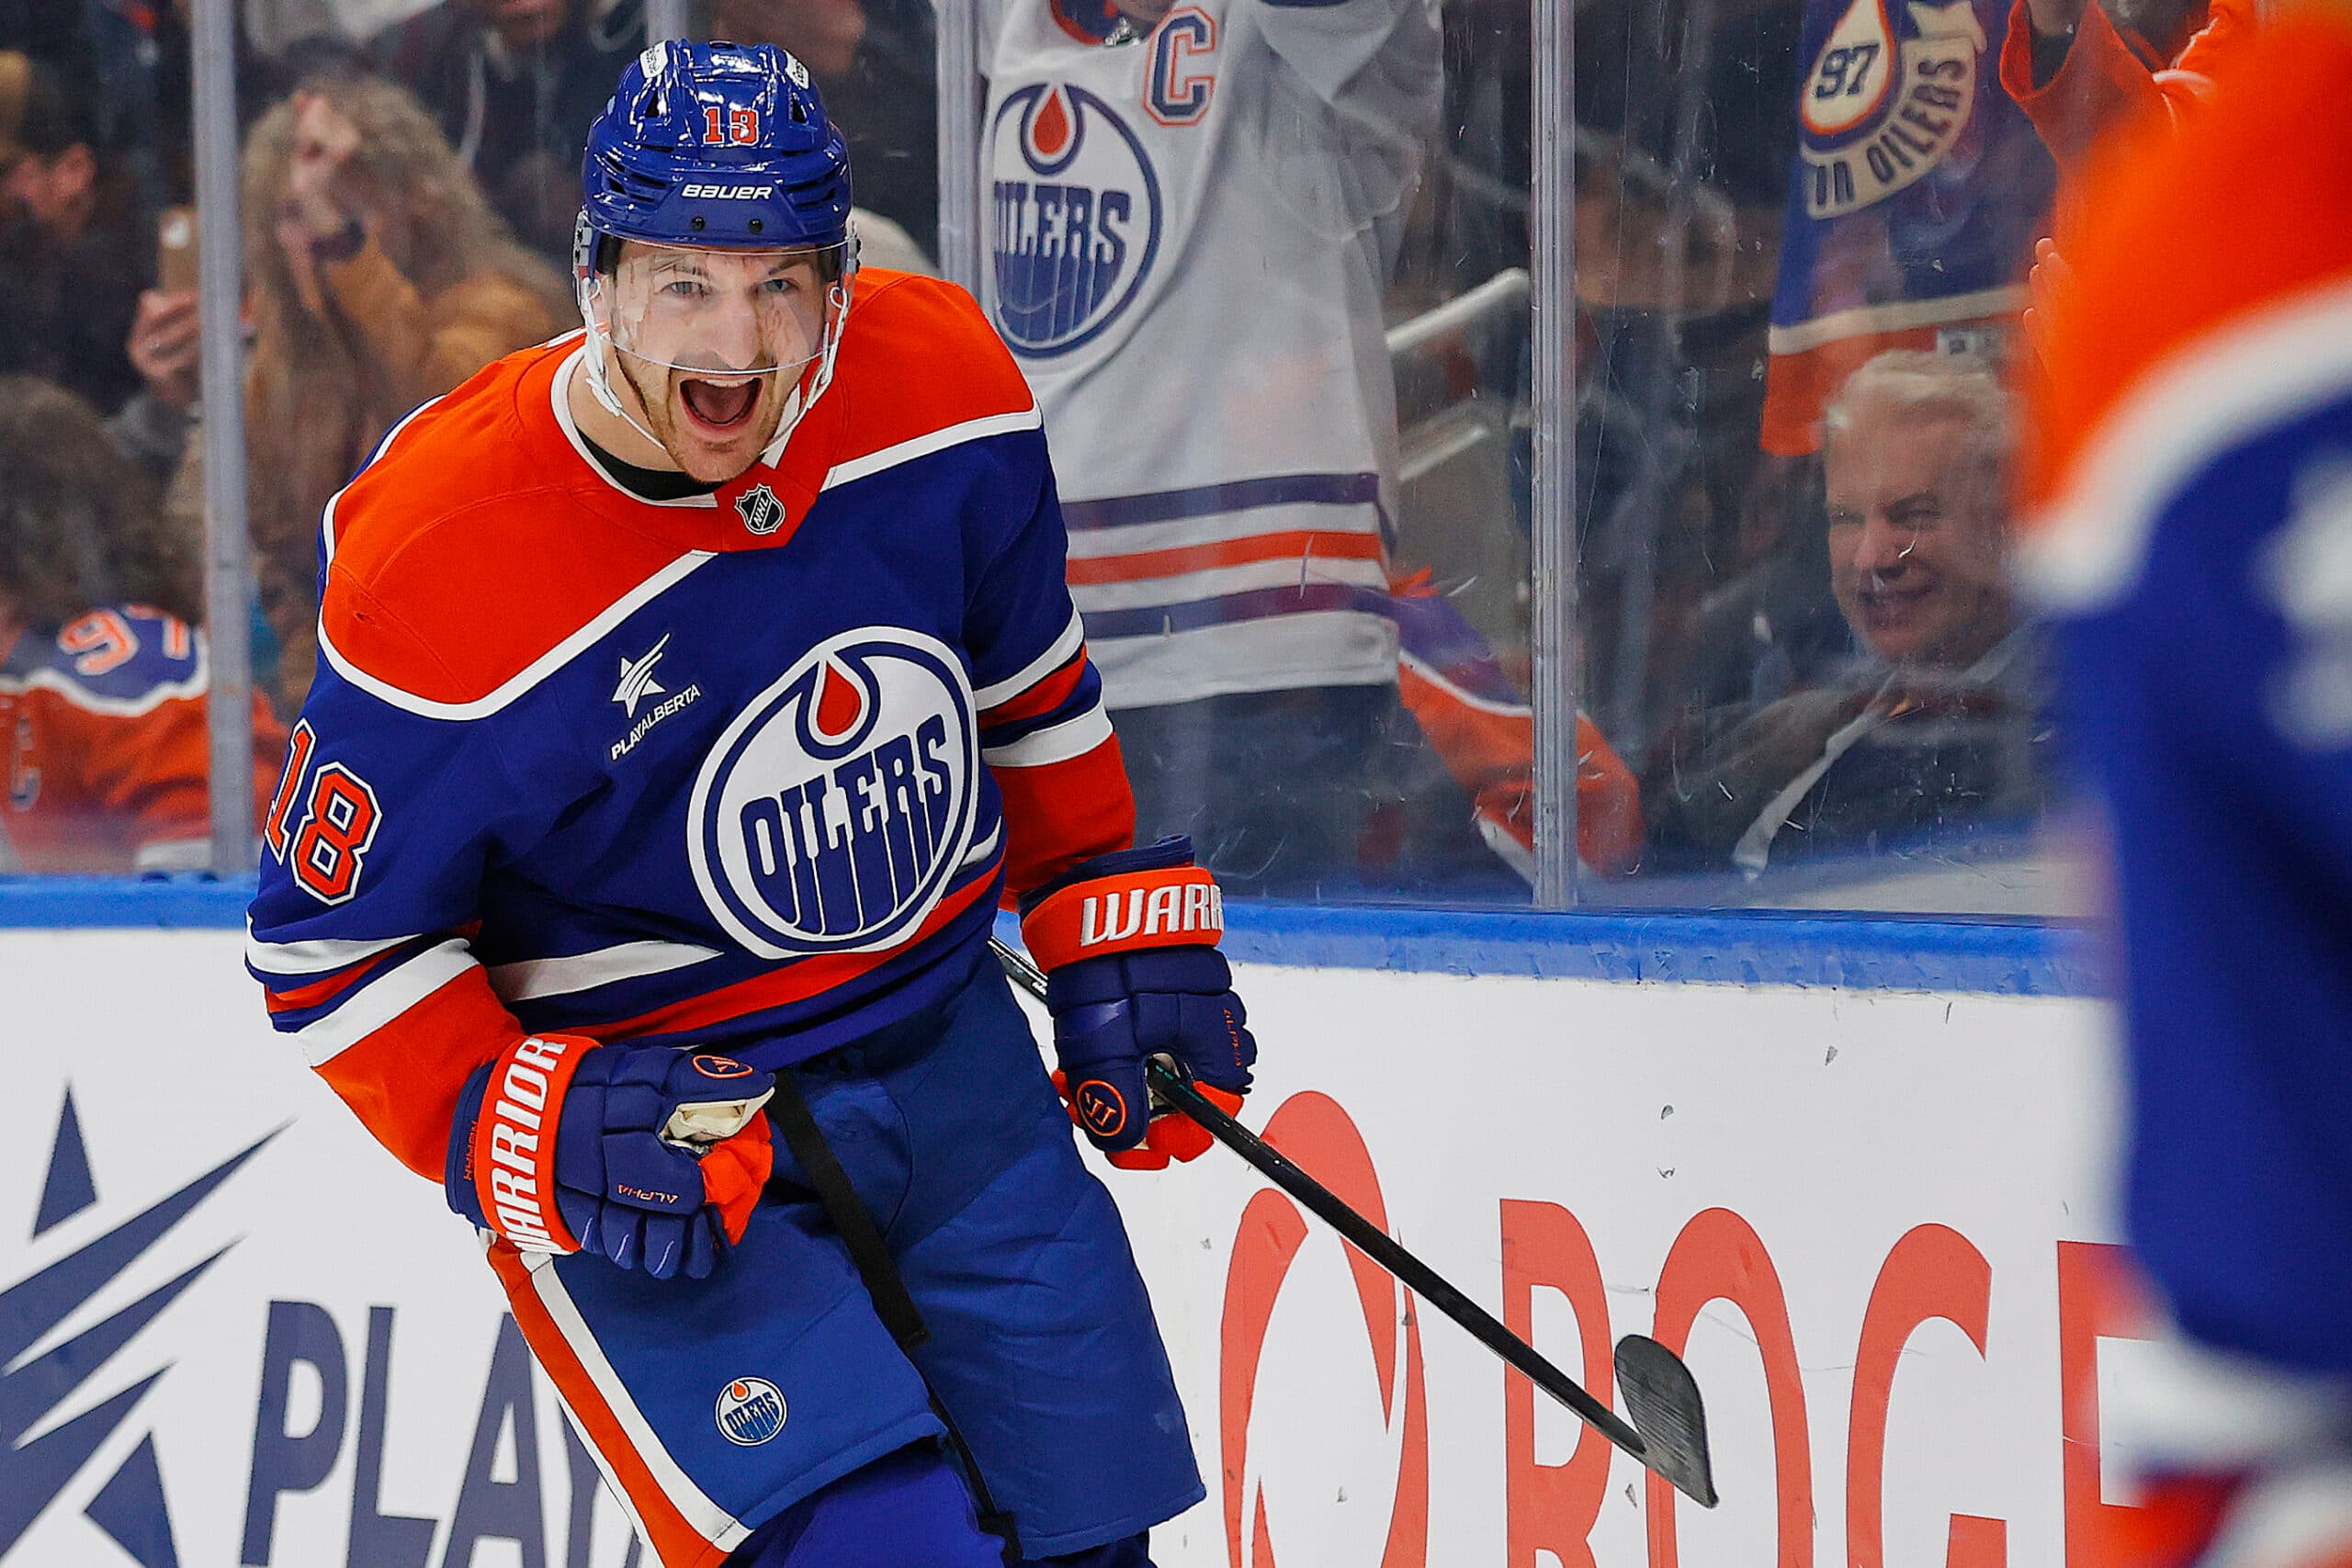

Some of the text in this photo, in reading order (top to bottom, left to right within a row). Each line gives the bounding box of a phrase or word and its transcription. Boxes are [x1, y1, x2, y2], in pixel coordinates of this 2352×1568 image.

[1144, 6, 1216, 127] C
[1815, 43, 1880, 98] 97
[681, 184, 773, 200] BAUER
[753, 497, 769, 527] NHL
[611, 683, 701, 761] PLAYALBERTA
[265, 717, 383, 907] 18
[739, 713, 953, 935] OILERS
[617, 1184, 679, 1204] ALPHA
[724, 1391, 780, 1441] OILERS
